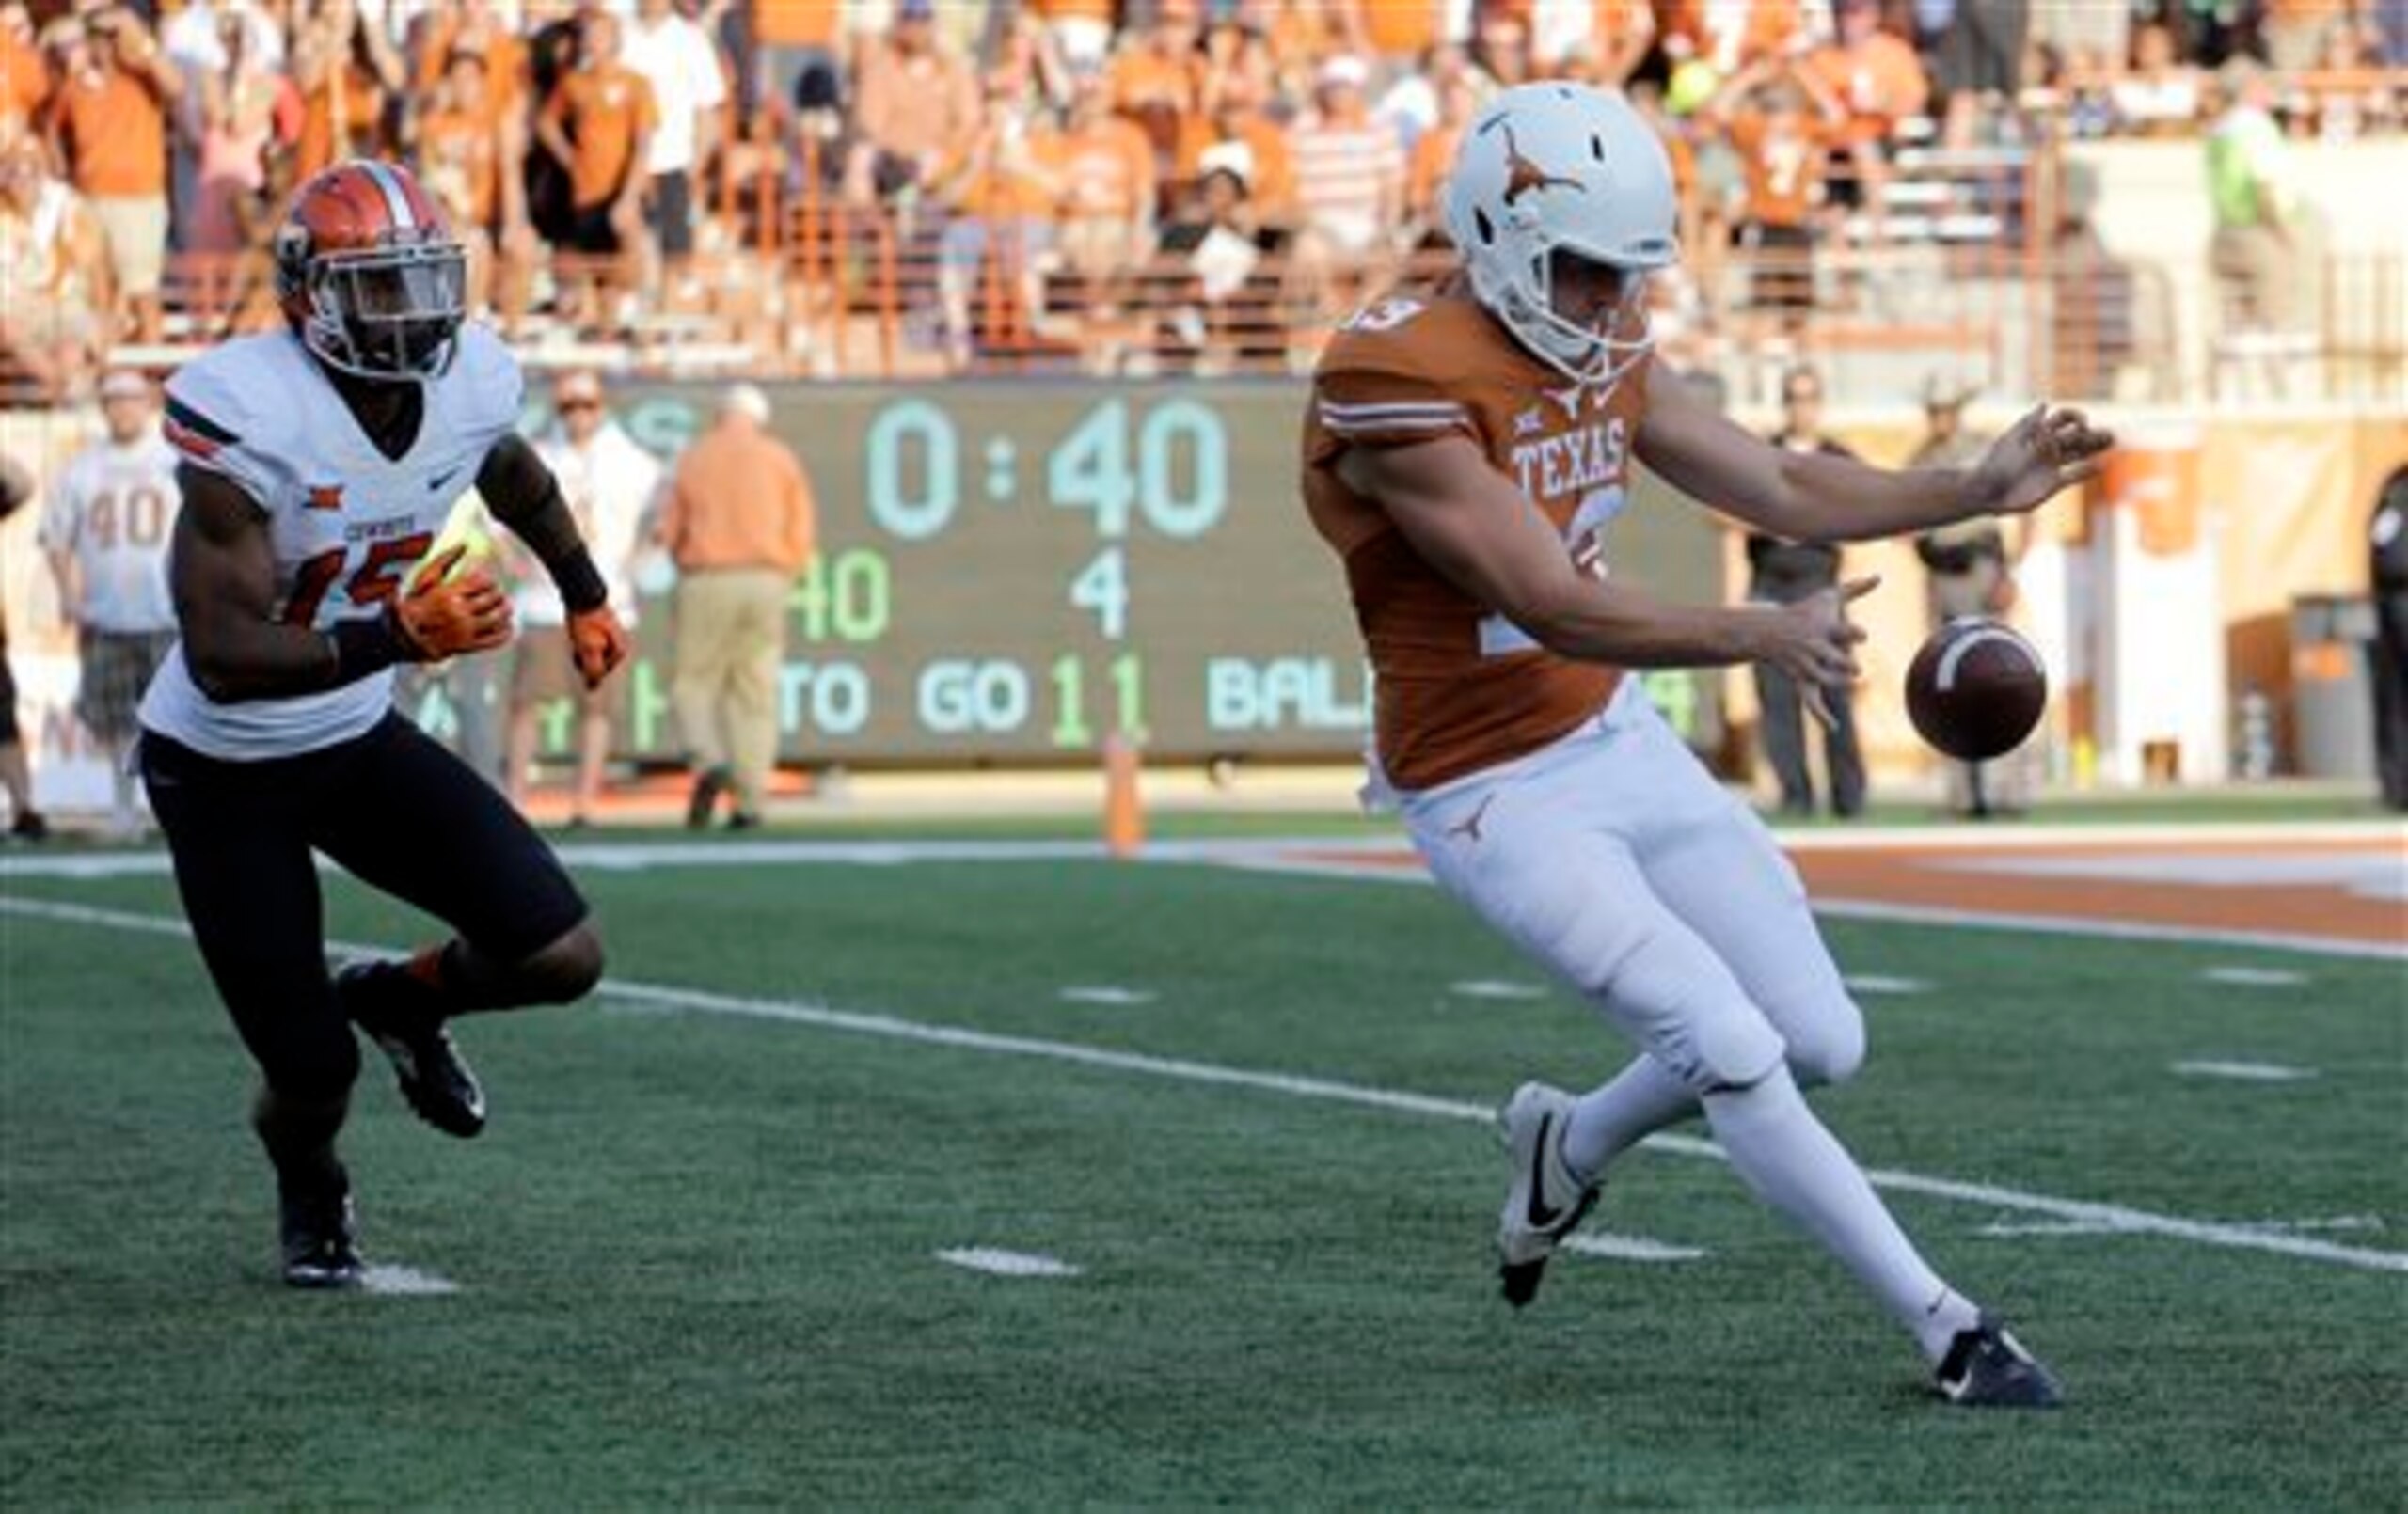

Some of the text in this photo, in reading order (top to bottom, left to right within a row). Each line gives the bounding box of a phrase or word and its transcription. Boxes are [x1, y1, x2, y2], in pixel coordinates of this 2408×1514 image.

[867, 398, 1228, 539] 0:40
[1512, 417, 1624, 498] TEXAS
[88, 487, 164, 550] 40
[1070, 548, 1129, 639] 4
[779, 655, 1374, 748] TO GO 11 BAL
